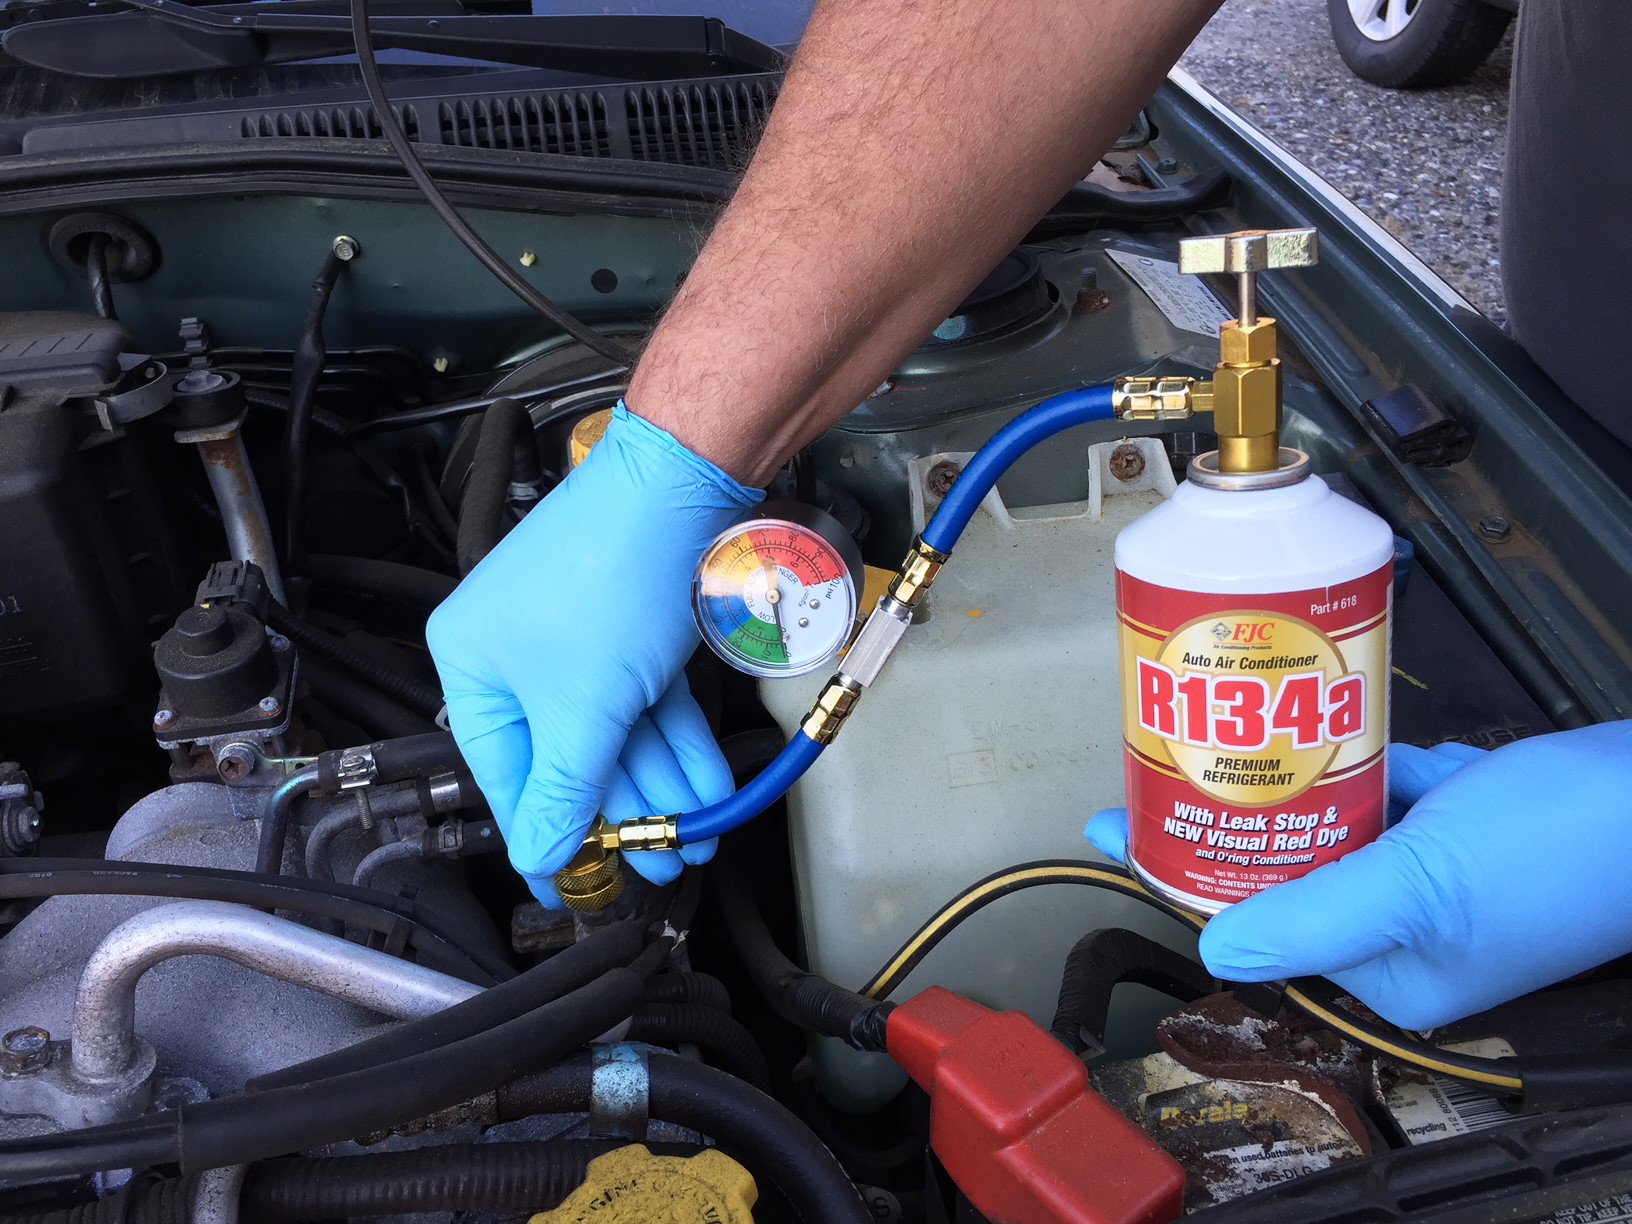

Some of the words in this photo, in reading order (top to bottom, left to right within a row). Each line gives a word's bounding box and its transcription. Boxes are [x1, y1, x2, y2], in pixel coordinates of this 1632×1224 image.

[730, 536, 741, 548] 60
[815, 546, 826, 558] 90
[825, 588, 834, 600] psi
[1310, 603, 1330, 616] Part
[1332, 600, 1339, 612] #
[1340, 595, 1357, 610] 618
[757, 612, 776, 622] LOW
[1231, 622, 1275, 642] FJC
[733, 636, 744, 648] 20
[761, 649, 771, 660] 10
[1182, 652, 1212, 668] Auto
[1215, 655, 1236, 669] Air
[1239, 653, 1318, 670] Conditioner
[1136, 656, 1366, 750] R134a
[1445, 726, 1530, 746] USE
[1214, 757, 1280, 772] PREMIUM
[1202, 770, 1295, 786] REFRIGERANT
[1174, 800, 1214, 826] With
[1219, 811, 1268, 832] Leak
[1276, 809, 1320, 832] Stop
[1323, 806, 1338, 826] &
[1164, 819, 1204, 843] NEW
[1207, 831, 1268, 852] Visual
[1272, 831, 1312, 851] Red
[1316, 824, 1348, 848] Dye
[1196, 847, 1216, 859] and
[1217, 851, 1250, 867] O'ring
[1253, 852, 1315, 866] Conditioner
[1184, 870, 1218, 884] WARNING:
[1218, 878, 1256, 889] CONTENTS
[1214, 869, 1226, 877] Net
[1262, 874, 1277, 882] (369
[1196, 882, 1214, 893] READ
[1214, 887, 1250, 898] WARNINGS
[1429, 1088, 1451, 1114] 80088
[1406, 1122, 1446, 1138] recycling
[1241, 1151, 1264, 1164] used
[1263, 1147, 1304, 1161] batteries
[1305, 1146, 1316, 1154] to
[1554, 1207, 1576, 1217] KEEP
[1578, 1202, 1598, 1212] OUT
[1598, 1198, 1611, 1208] OF
[1612, 1193, 1632, 1204] THE
[1556, 1214, 1576, 1224] NOT
[1597, 1206, 1620, 1220] KEEP
